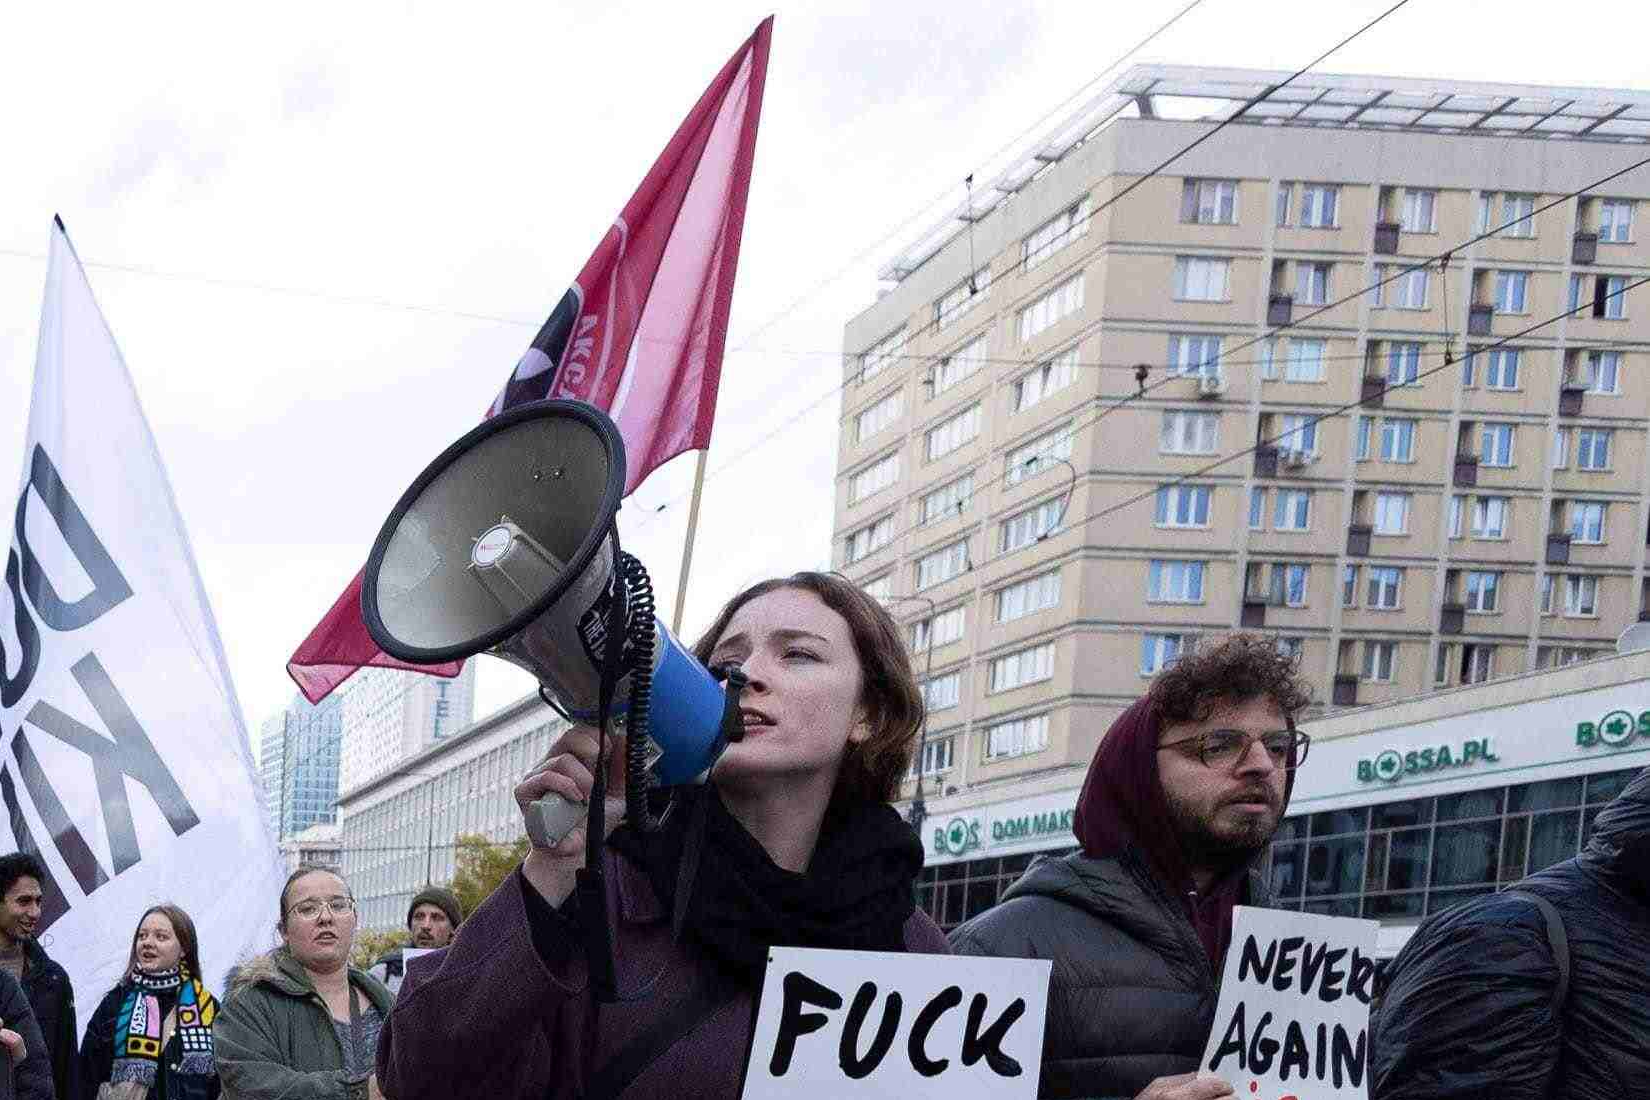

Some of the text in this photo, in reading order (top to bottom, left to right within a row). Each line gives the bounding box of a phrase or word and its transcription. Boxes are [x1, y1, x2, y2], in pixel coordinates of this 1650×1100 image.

[1356, 737, 1501, 782] BOSSA.PL
[1033, 810, 1073, 835] MAK
[1238, 934, 1374, 1004] NEVER
[769, 971, 1026, 1079] FUCK
[1209, 1001, 1367, 1089] AGAIN
